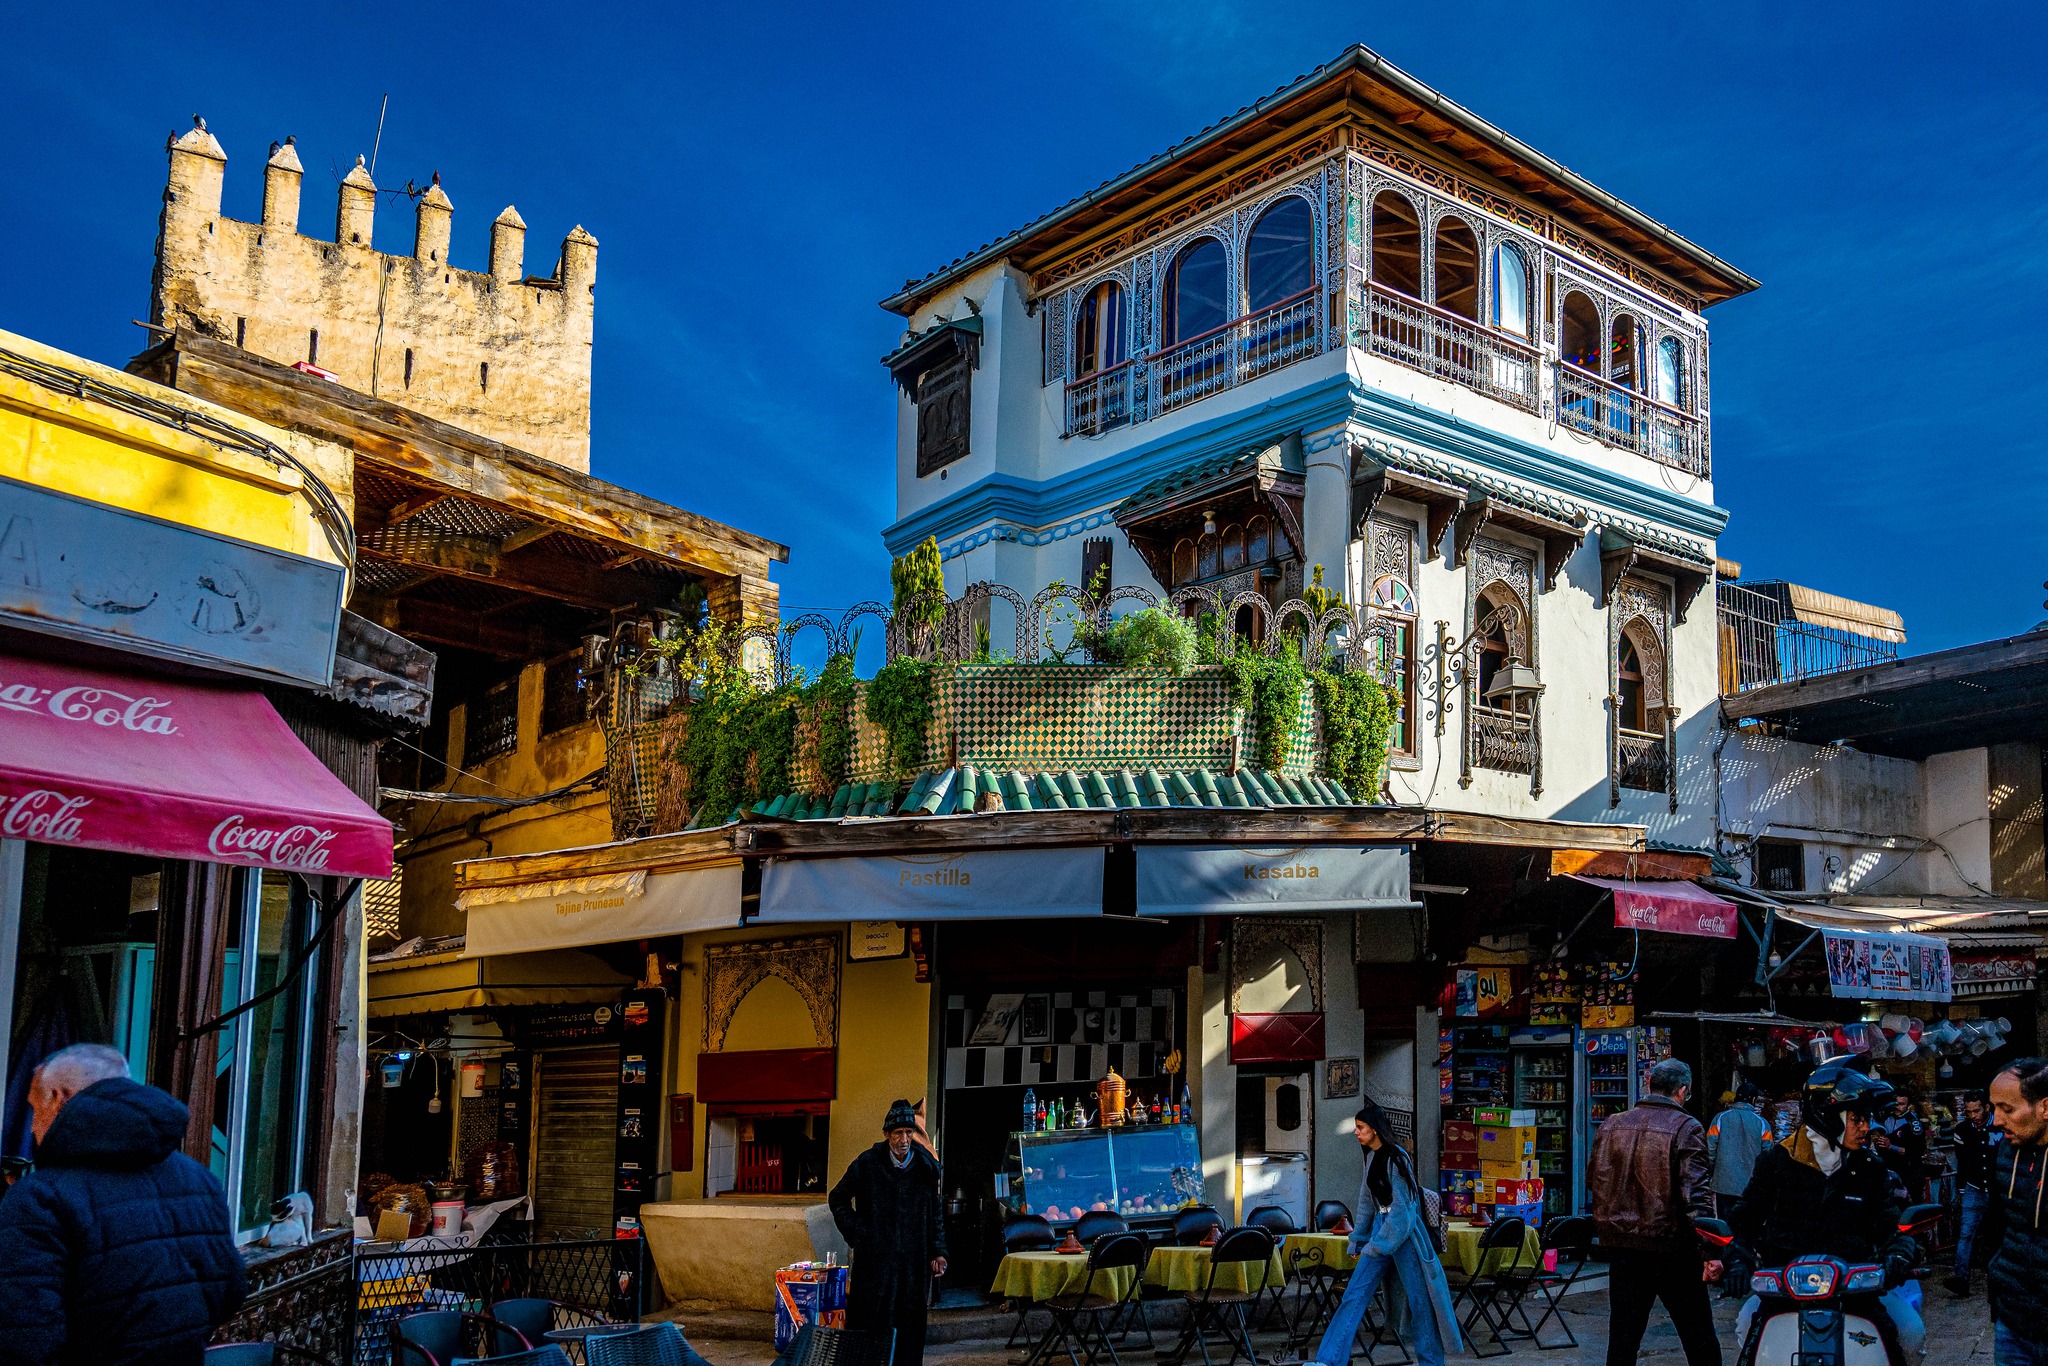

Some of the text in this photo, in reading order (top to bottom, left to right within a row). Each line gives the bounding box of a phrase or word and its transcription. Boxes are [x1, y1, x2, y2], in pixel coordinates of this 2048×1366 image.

[0, 682, 179, 735] a-Cola
[208, 814, 339, 869] Coca-Cola
[899, 868, 970, 887] Pastilla
[1244, 863, 1319, 880] Kasaba
[555, 896, 625, 917] Tajine Pruneaux
[1629, 903, 1658, 925] Coca-Cola
[1698, 913, 1726, 933] Coca-Cola
[1601, 1041, 1628, 1054] pepsi
